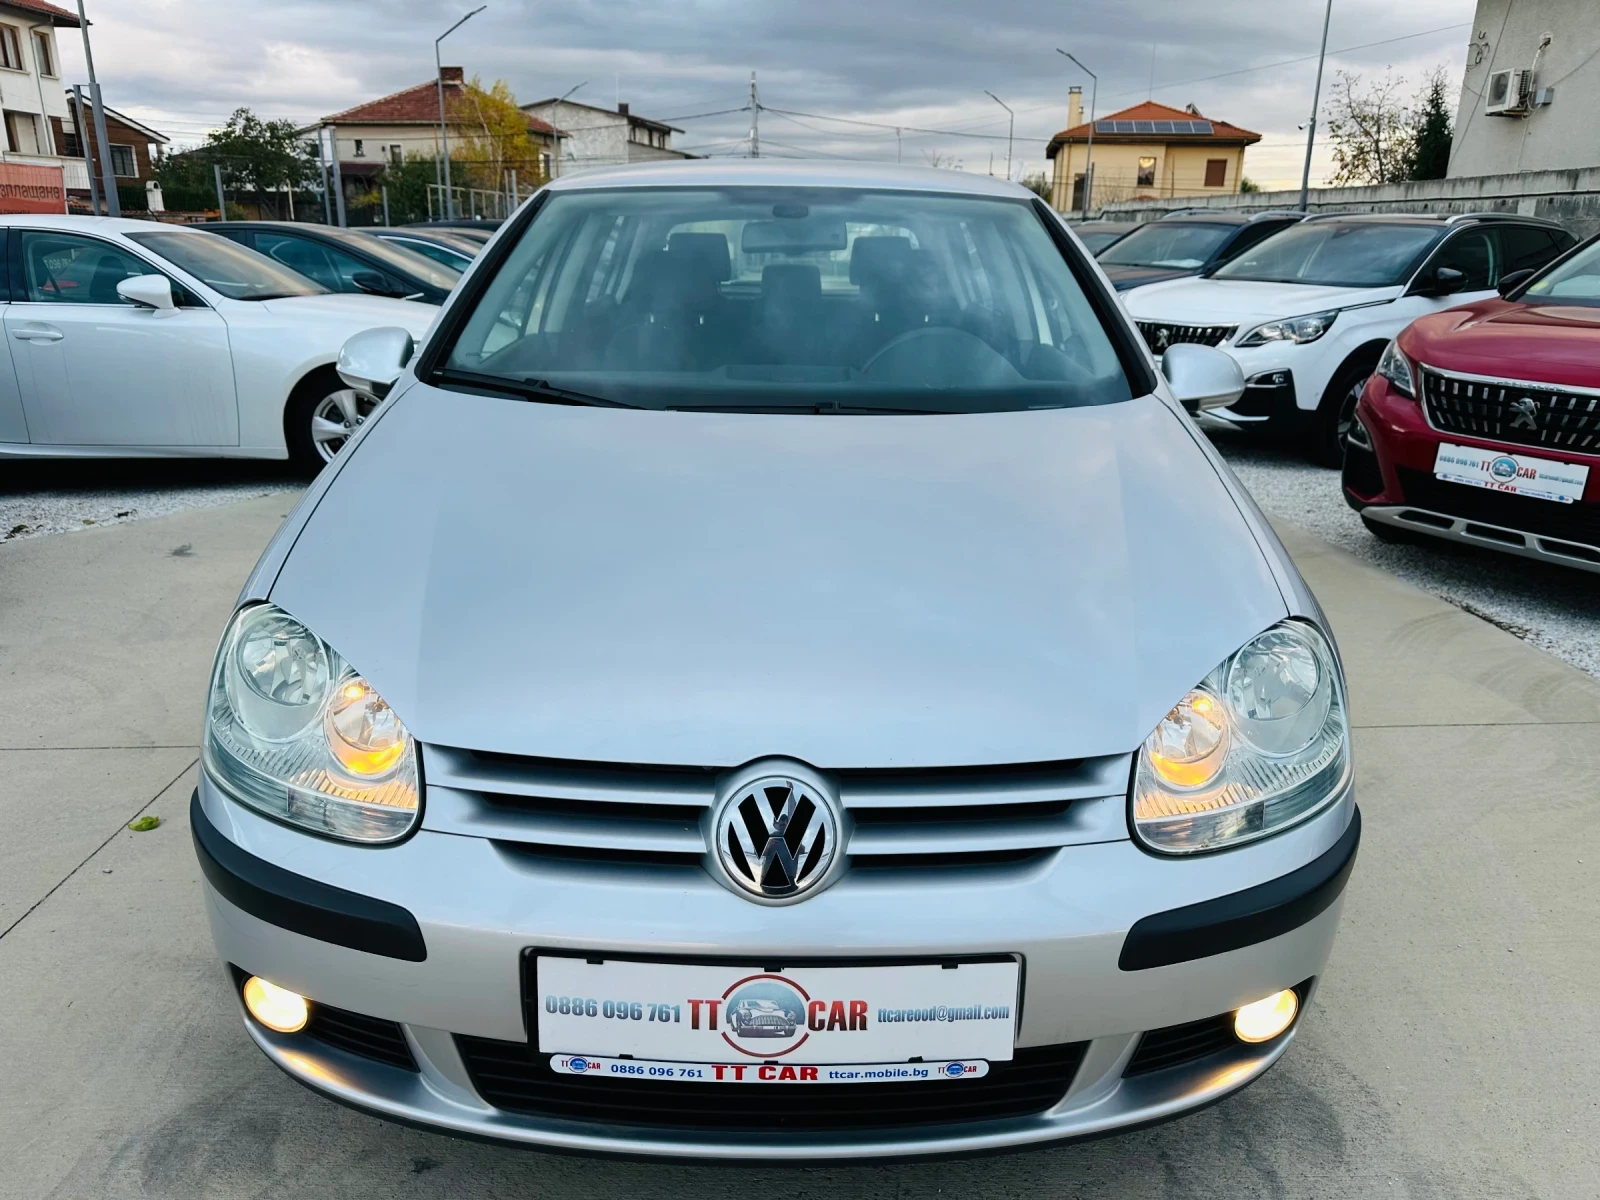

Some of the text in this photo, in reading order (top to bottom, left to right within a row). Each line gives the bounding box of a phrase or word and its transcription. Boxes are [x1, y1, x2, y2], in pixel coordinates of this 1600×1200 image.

[1481, 460, 1492, 471] TT
[1516, 467, 1537, 480] CAR
[1498, 483, 1517, 492] CAR
[545, 994, 1009, 1032] 0886 096 761 TT CAR ttcareood@gmail.com
[561, 1059, 977, 1081] TT CAR 0886 096 761 TT CAR ttcar.mobile.bg TT CAR
